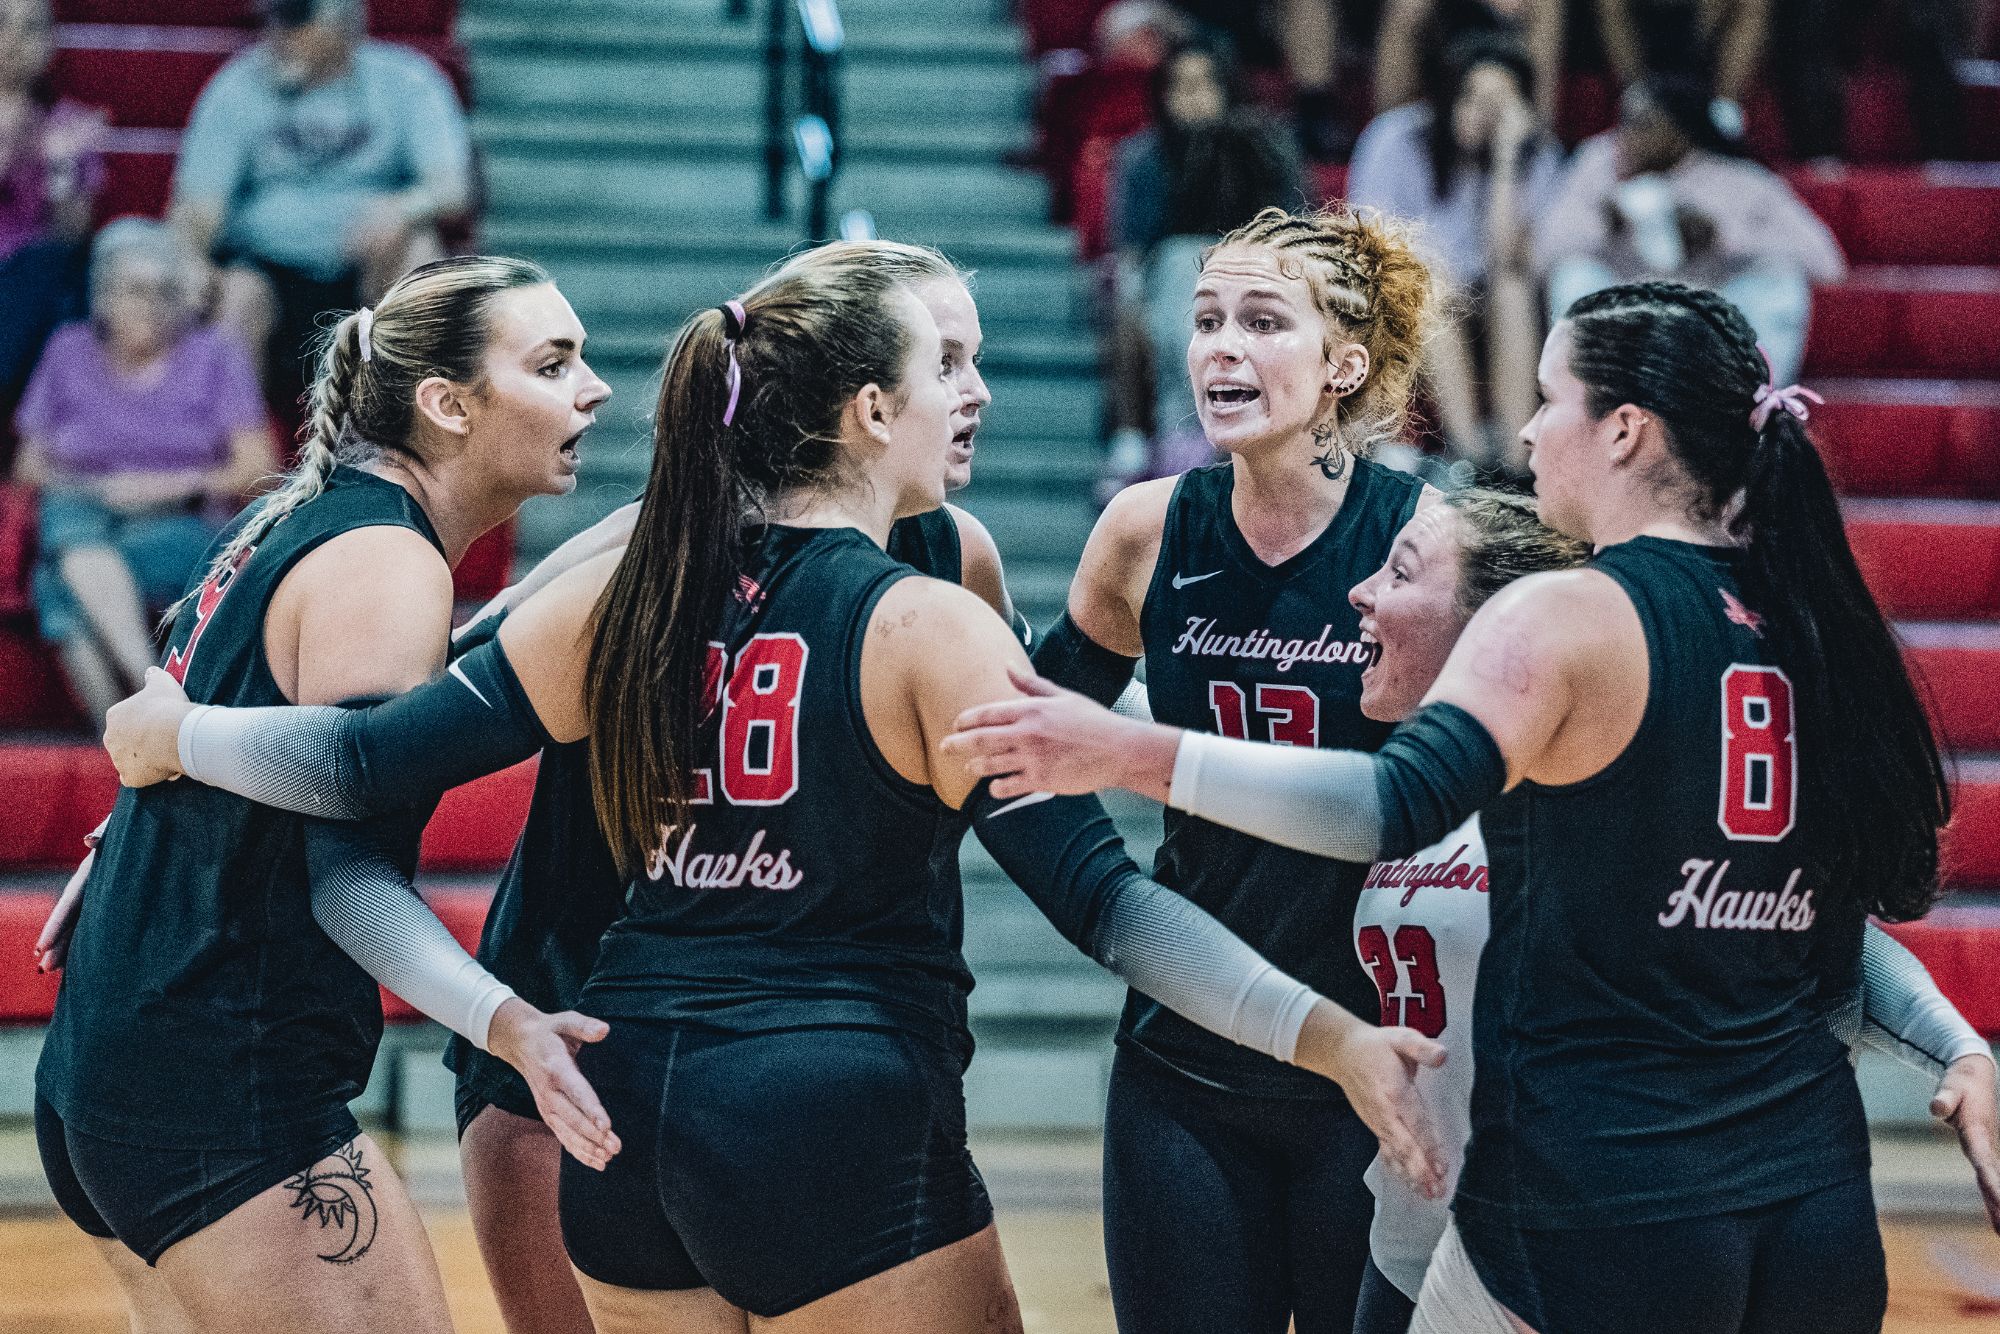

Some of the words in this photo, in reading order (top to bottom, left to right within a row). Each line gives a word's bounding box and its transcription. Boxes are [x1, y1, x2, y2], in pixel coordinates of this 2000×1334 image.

[1172, 616, 1369, 672] Huntingdon
[1208, 680, 1320, 749] 13
[1717, 662, 1798, 842] 8
[1363, 844, 1489, 907] untingdon
[1658, 858, 1816, 931] Hawks
[1358, 925, 1447, 1038] 23
